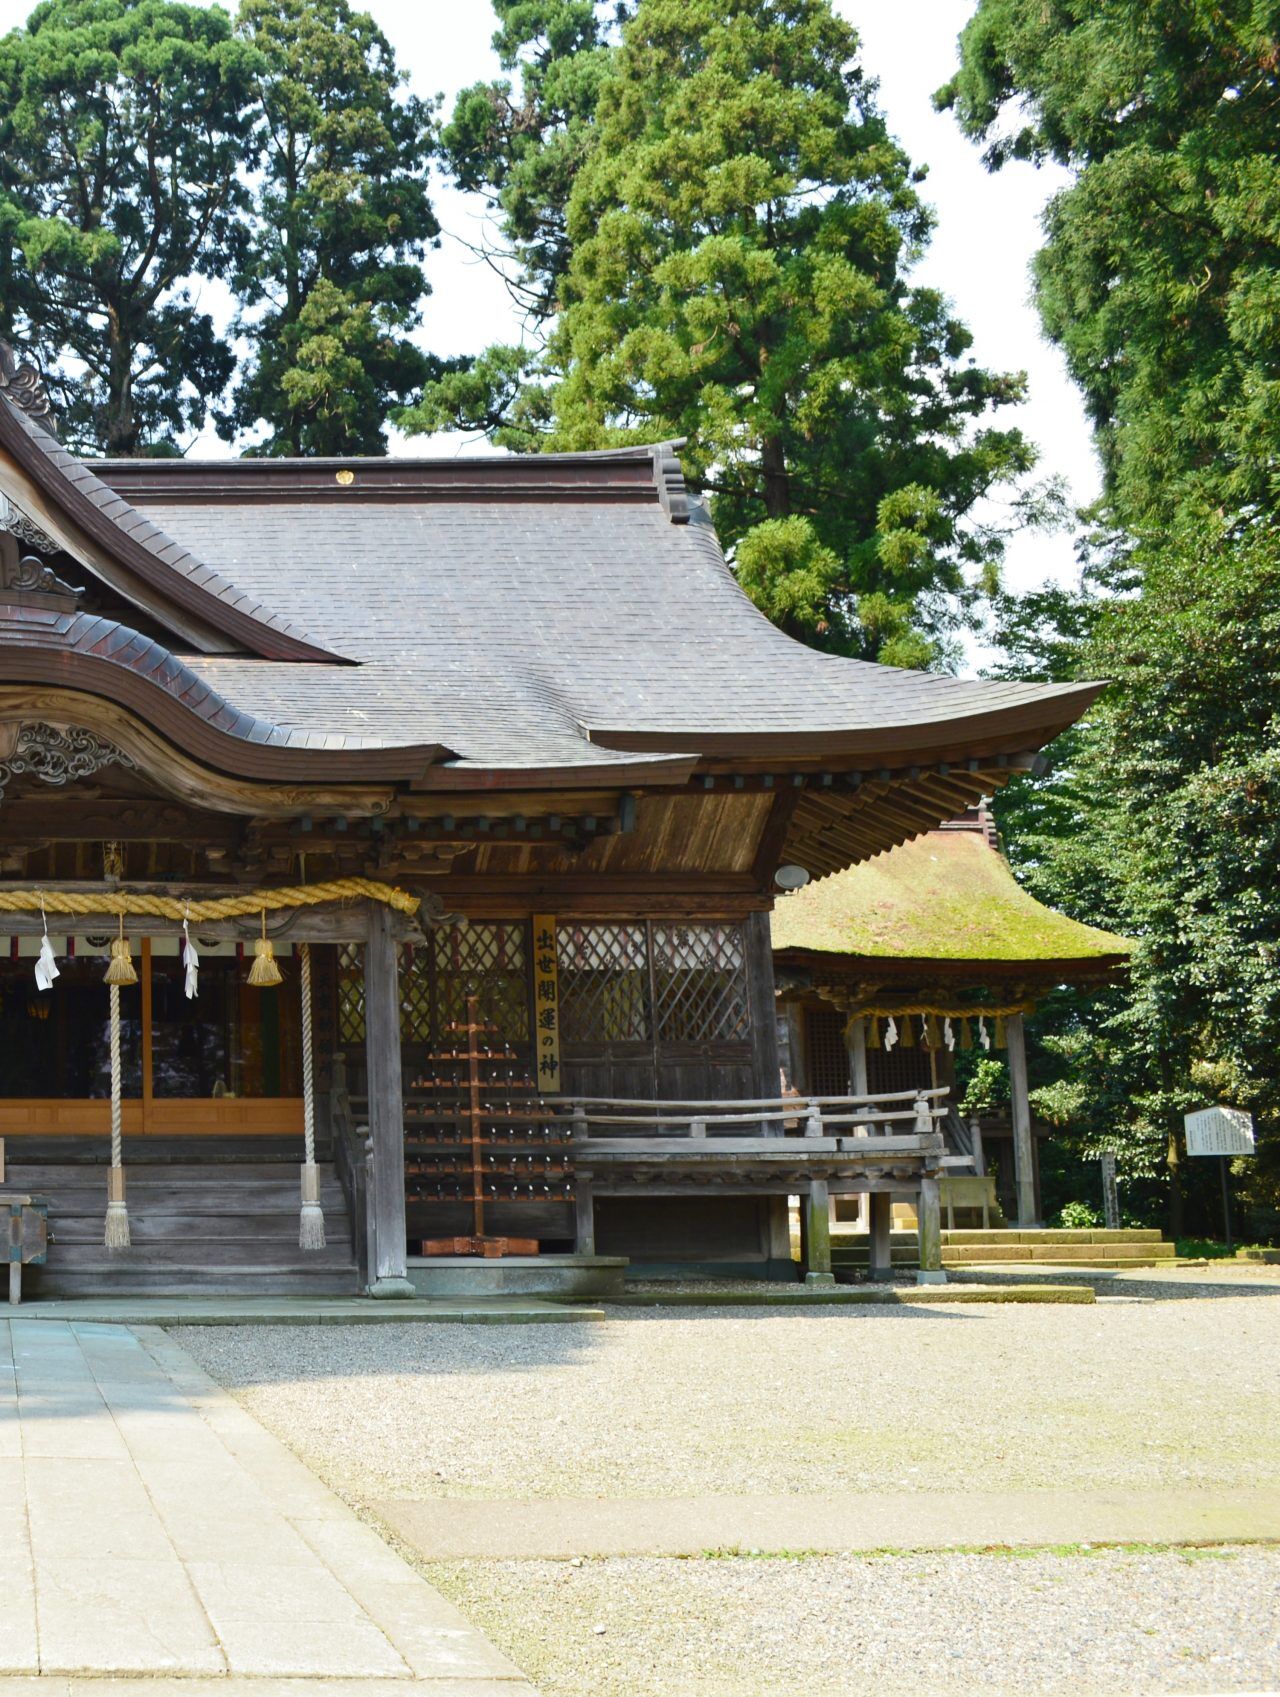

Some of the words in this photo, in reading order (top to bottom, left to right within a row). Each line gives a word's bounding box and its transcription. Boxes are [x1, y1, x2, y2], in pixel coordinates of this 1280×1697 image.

[536, 929, 558, 1078] 出世開運の神
